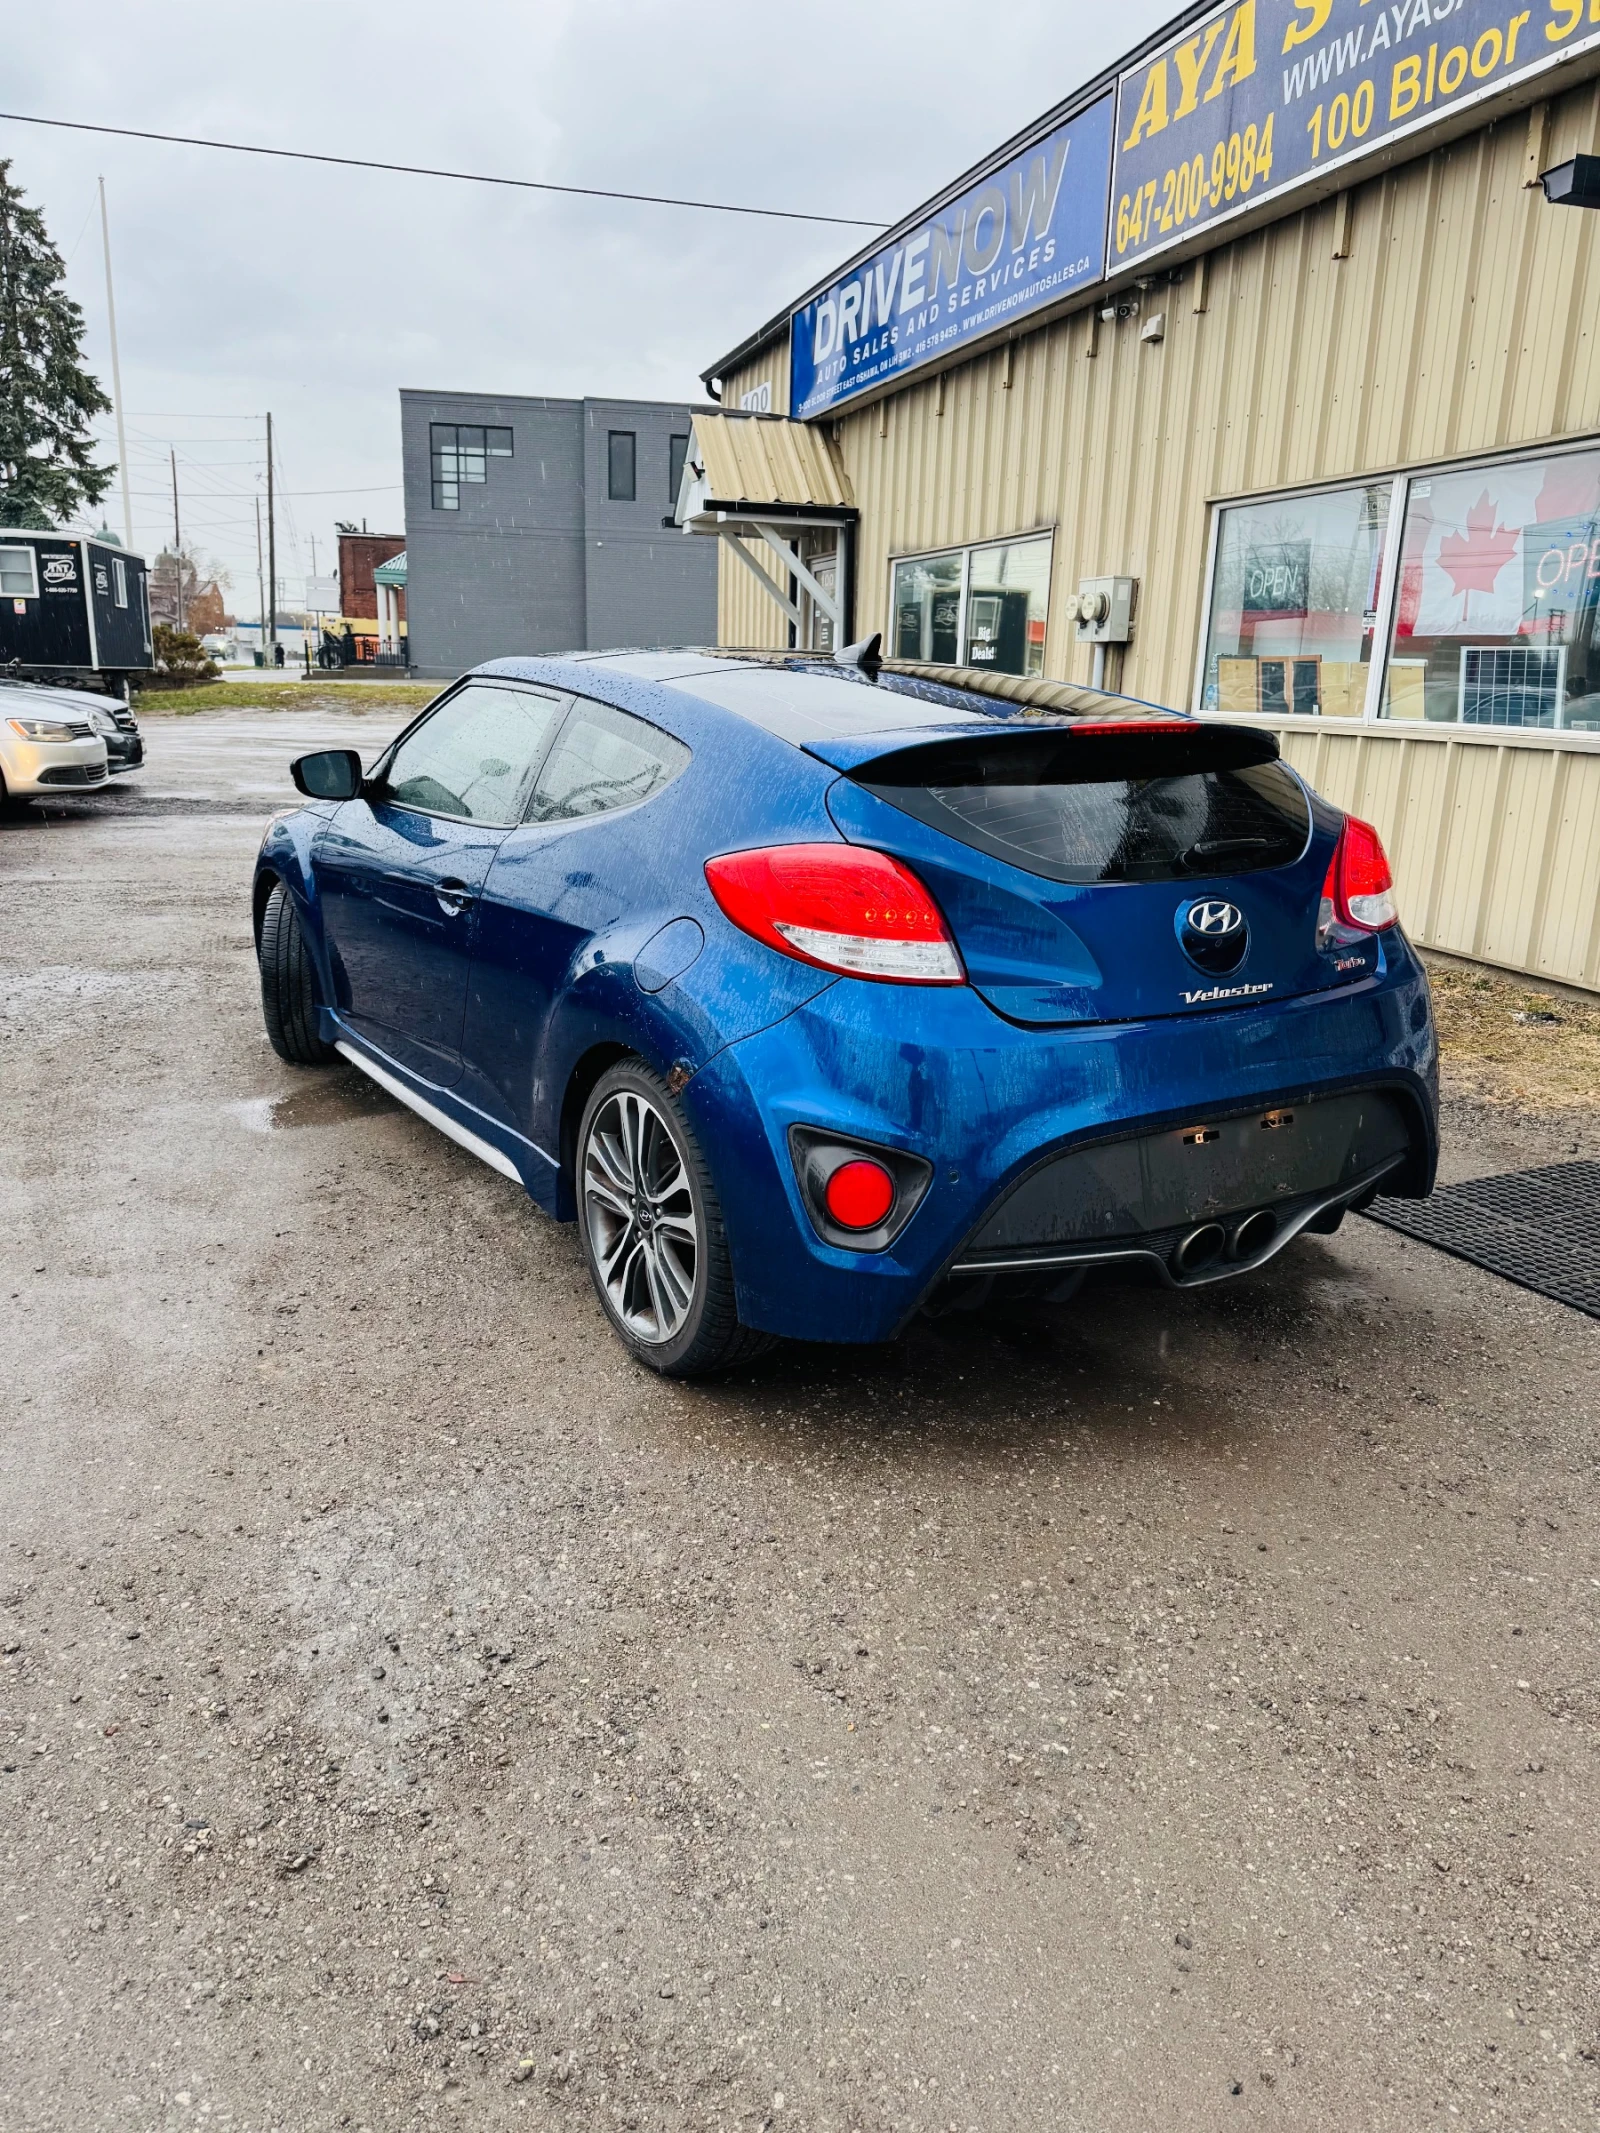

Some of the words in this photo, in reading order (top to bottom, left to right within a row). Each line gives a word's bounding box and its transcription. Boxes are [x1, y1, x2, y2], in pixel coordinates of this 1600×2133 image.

[1123, 0, 1257, 152] AYA
[1307, 80, 1374, 159] 100
[1389, 10, 1531, 121] Bloor
[1116, 112, 1274, 254] 647-200-9984
[817, 355, 847, 385] AUTO
[853, 326, 899, 365] SALES
[906, 303, 939, 336] AND
[948, 238, 1055, 314] SERVICES
[843, 376, 856, 390] EAST
[926, 333, 940, 349] 578
[940, 323, 958, 342] 9459
[963, 255, 1090, 331] WWW.DRIVENOWAUTOSALES.CA
[1366, 501, 1389, 513] UCDA
[977, 626, 991, 643] Big
[1250, 564, 1299, 598] OPEN
[1179, 982, 1274, 1004] Veloster
